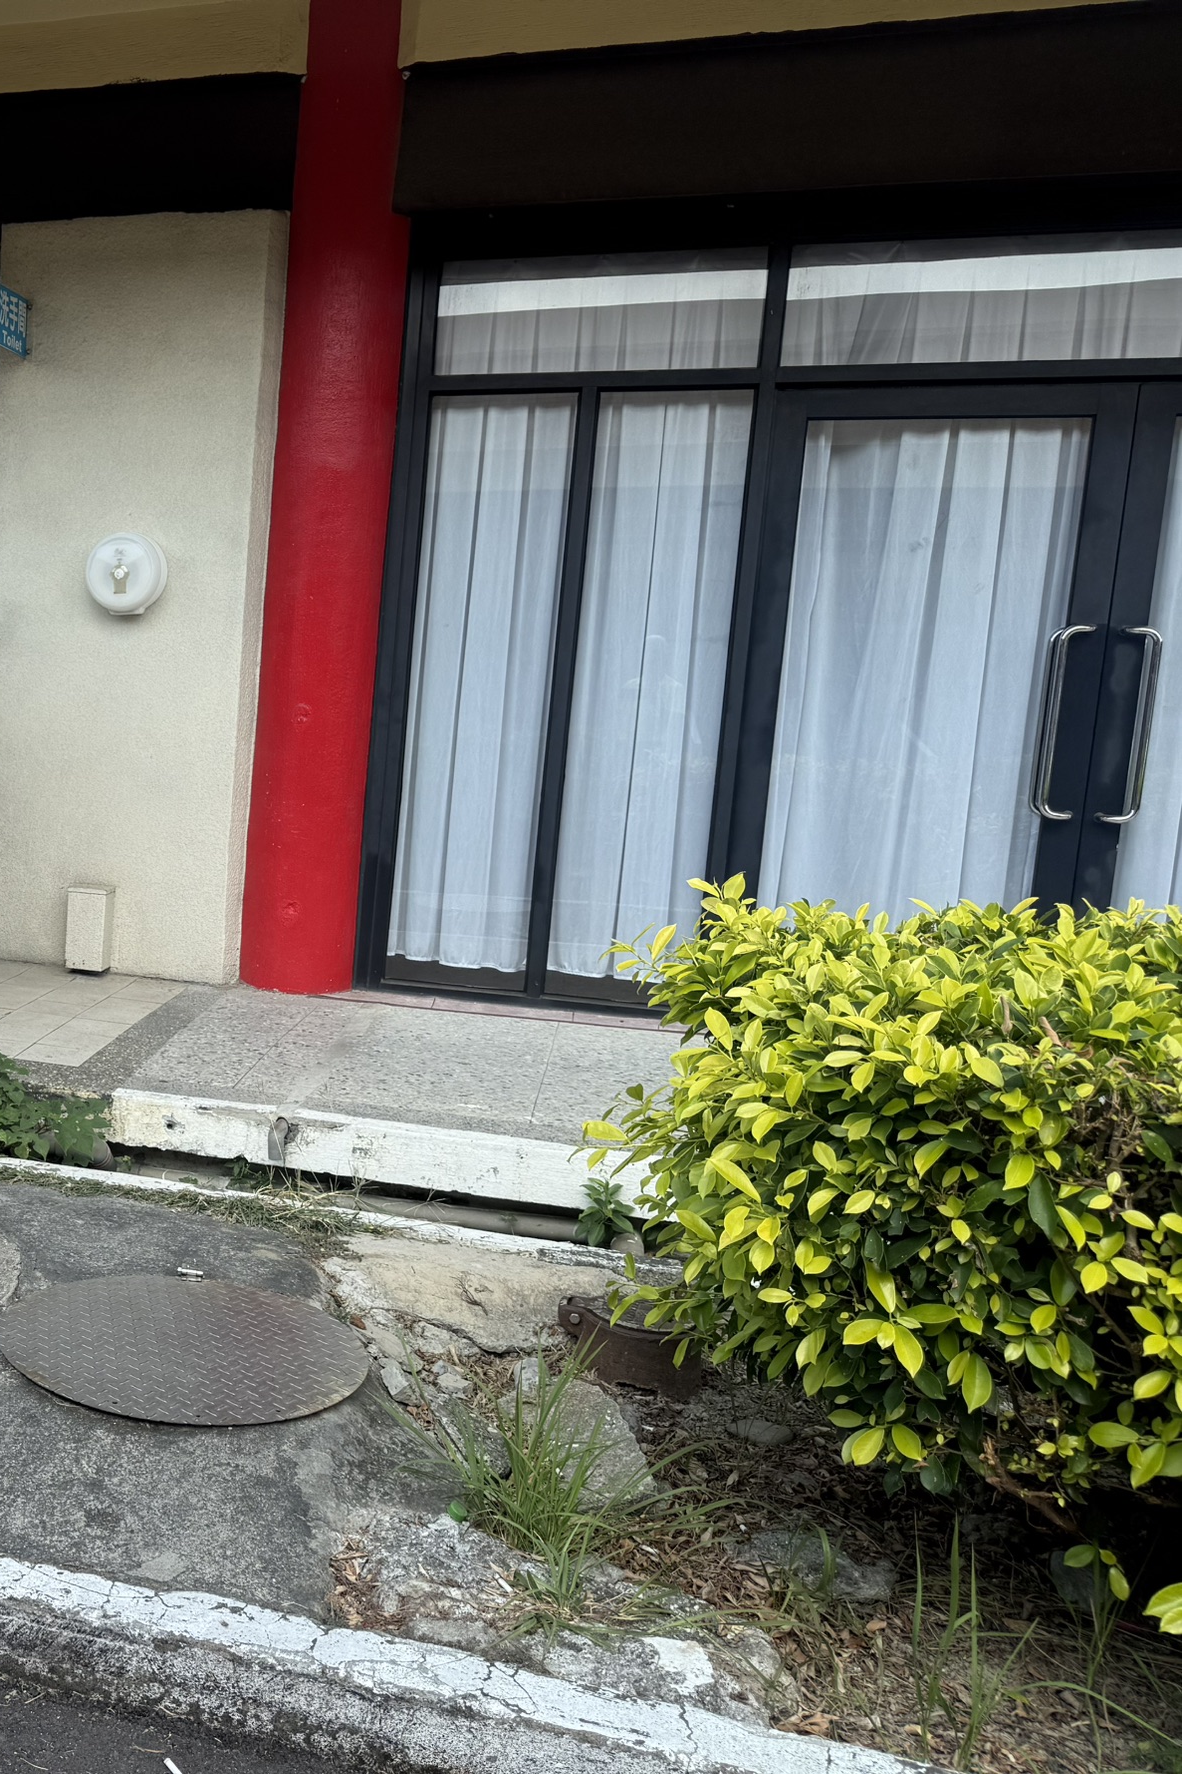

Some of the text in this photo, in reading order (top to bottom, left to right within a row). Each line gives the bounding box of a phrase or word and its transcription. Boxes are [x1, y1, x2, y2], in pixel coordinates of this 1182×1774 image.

[0, 289, 27, 338] 洗手間
[1, 329, 23, 353] Toilet
